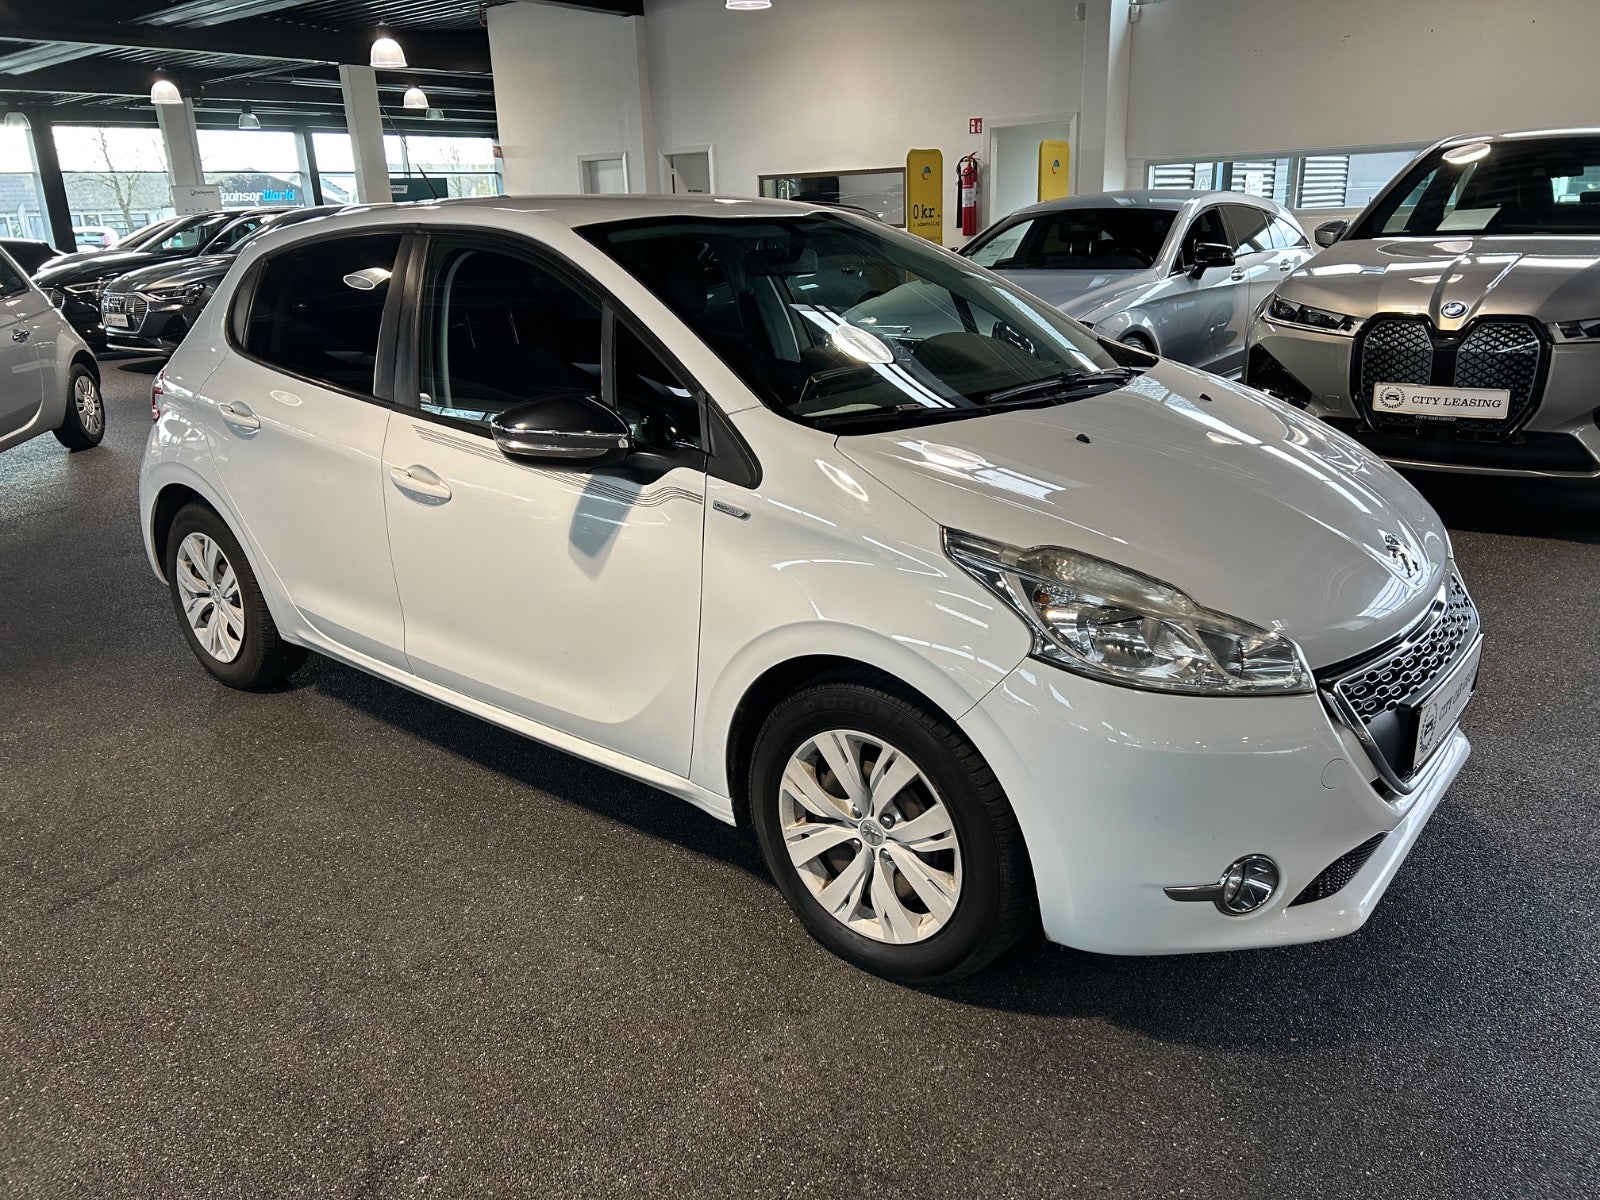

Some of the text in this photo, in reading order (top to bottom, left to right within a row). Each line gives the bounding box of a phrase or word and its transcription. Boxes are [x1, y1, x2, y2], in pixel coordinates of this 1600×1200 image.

[222, 188, 295, 205] ponsorWorld
[913, 204, 941, 219] 0 kr.
[1411, 395, 1501, 408] CITY LEASING
[1439, 699, 1453, 720] CITY
